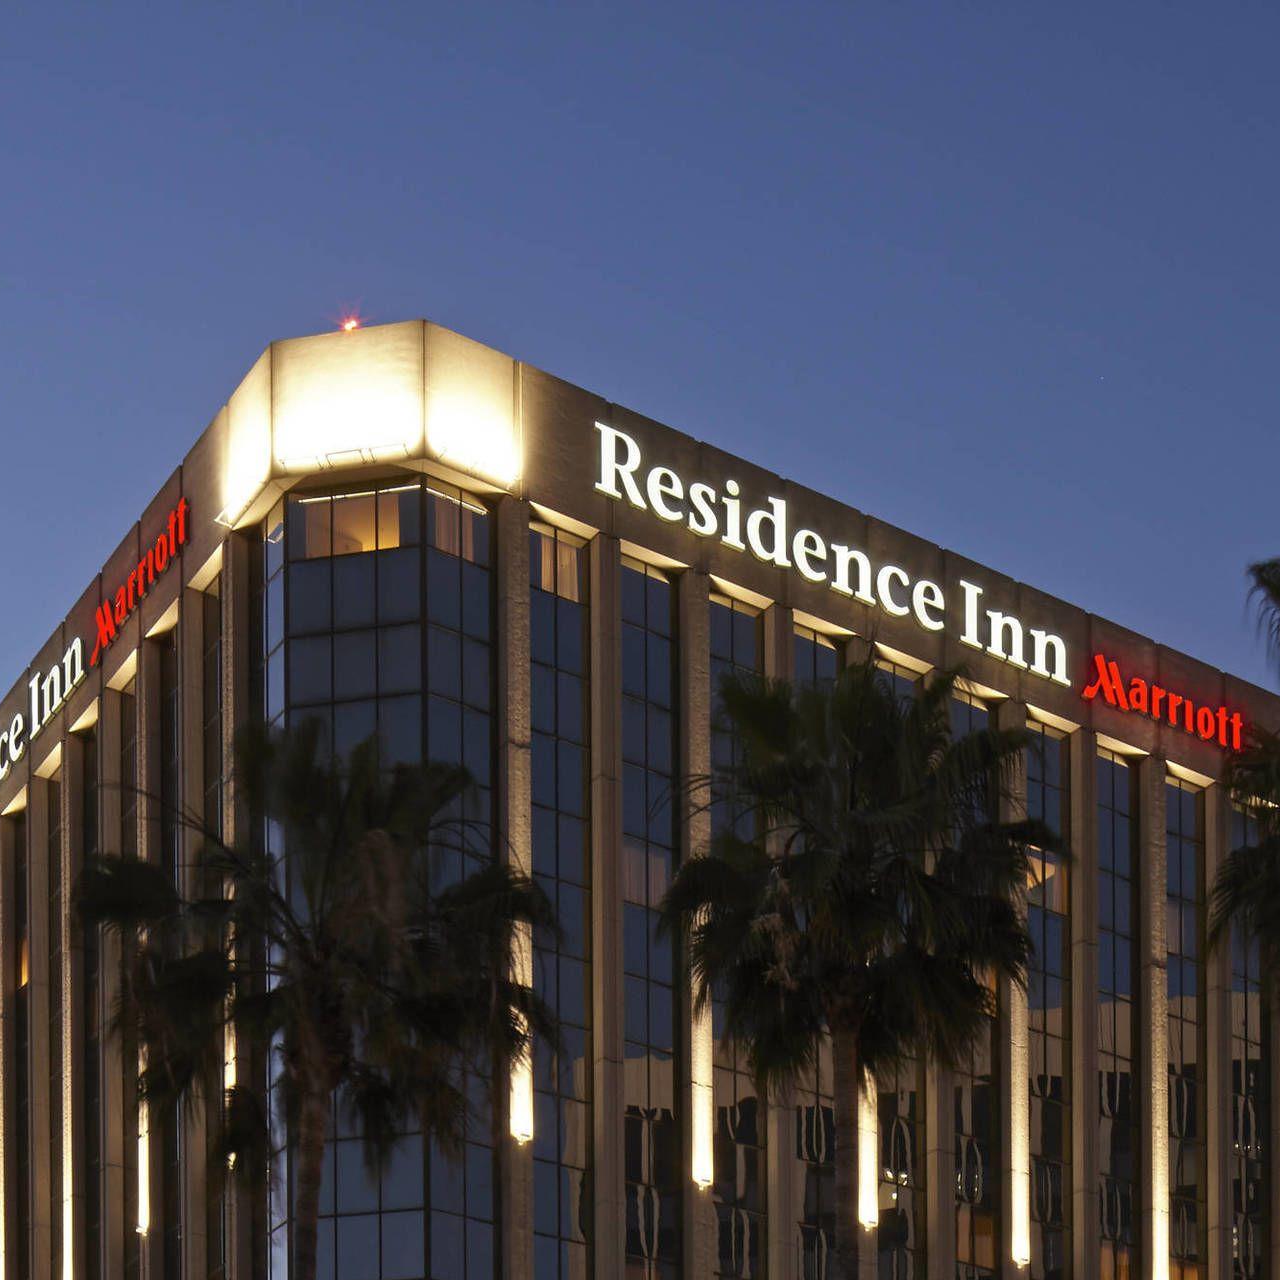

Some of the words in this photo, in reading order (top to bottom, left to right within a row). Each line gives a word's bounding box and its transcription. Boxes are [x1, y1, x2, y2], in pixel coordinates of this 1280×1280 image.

[28, 635, 87, 740] Inn
[89, 497, 188, 667] Marriott
[592, 421, 946, 633] Residence
[959, 579, 1072, 688] Inn
[1082, 654, 1244, 752] Marriott
